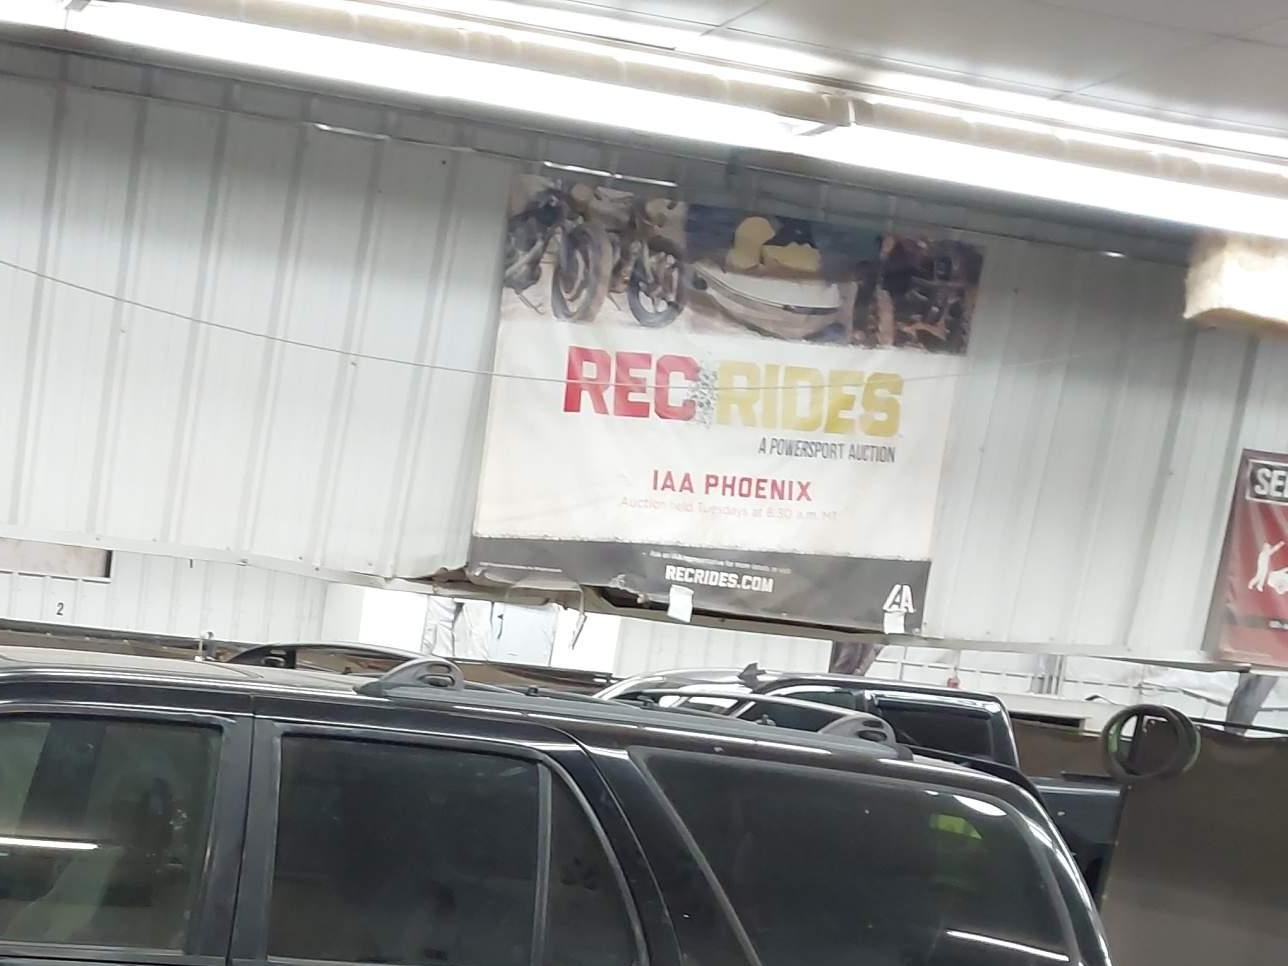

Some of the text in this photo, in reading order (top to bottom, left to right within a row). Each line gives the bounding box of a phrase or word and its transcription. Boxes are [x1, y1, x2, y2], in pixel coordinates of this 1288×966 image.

[563, 345, 904, 438] REC RIDES
[758, 437, 896, 464] A POWERSPORT AUCTION
[652, 469, 813, 502] IAA PHOENIX
[665, 565, 774, 593] RECRIDES.COM
[56, 602, 64, 616] 2
